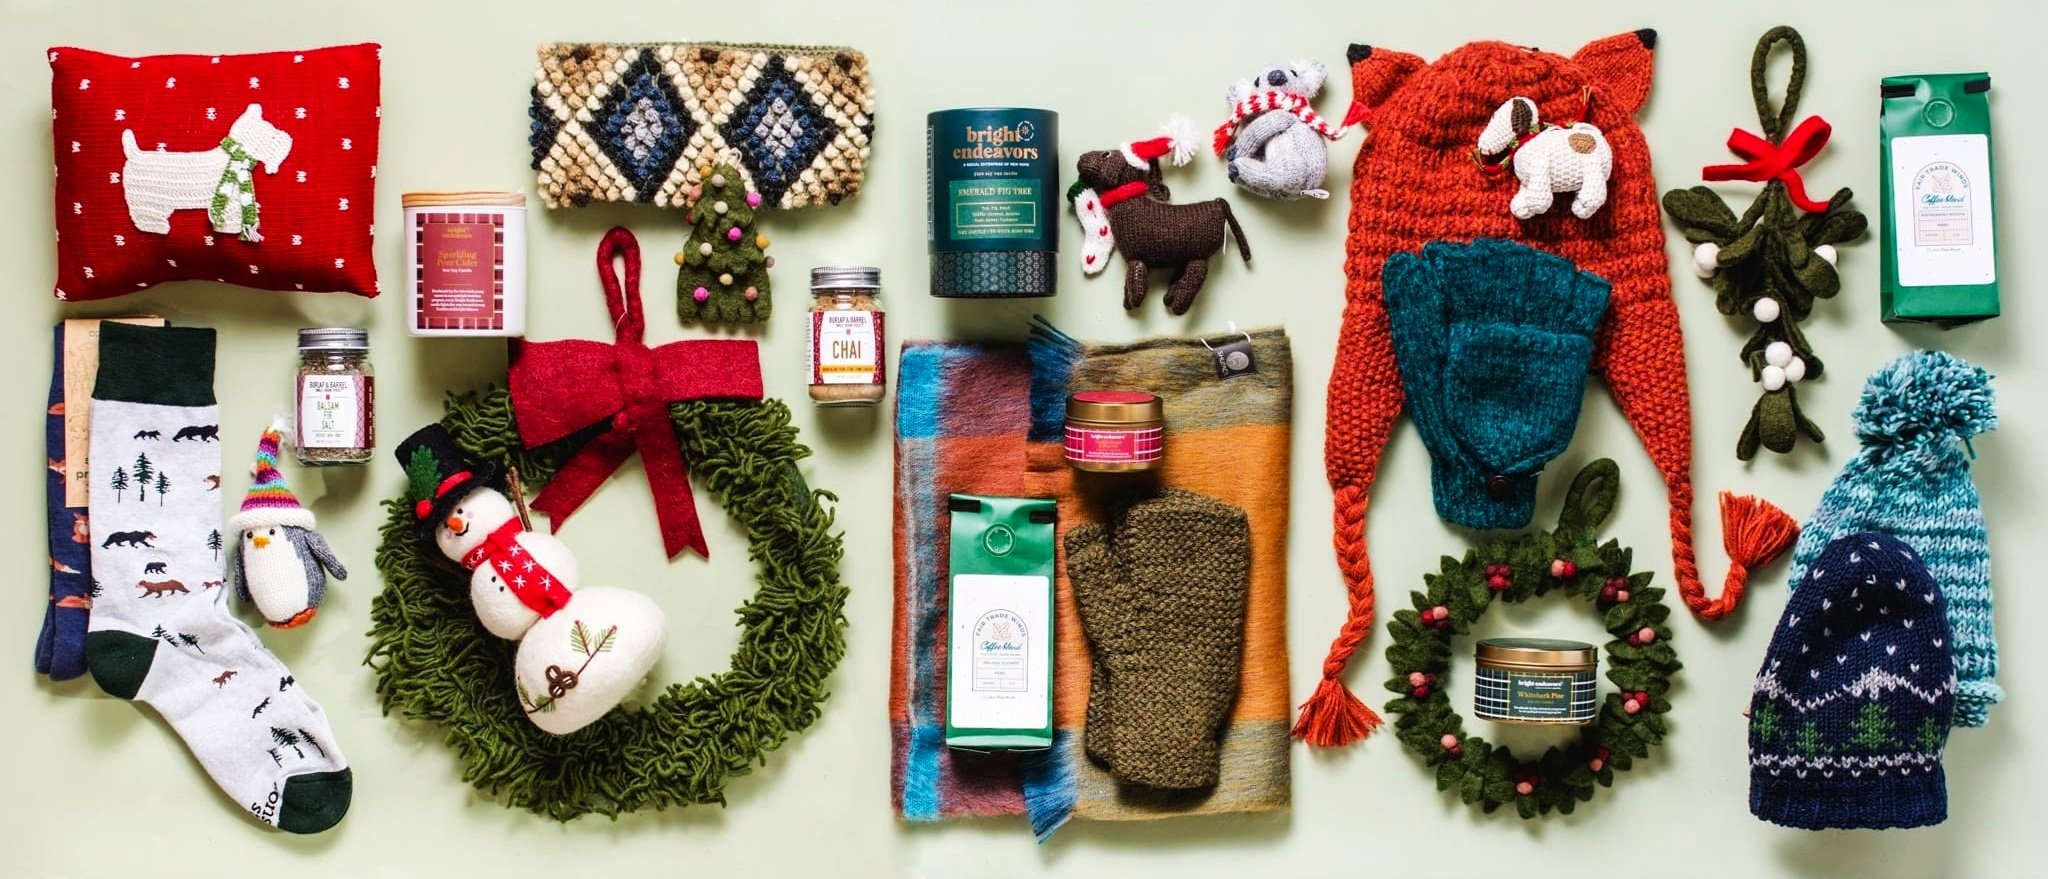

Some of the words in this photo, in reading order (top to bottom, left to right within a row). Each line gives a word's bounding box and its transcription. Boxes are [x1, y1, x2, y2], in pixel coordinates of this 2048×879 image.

[966, 126, 1021, 146] bright
[953, 143, 1038, 160] endeavors
[1916, 174, 1926, 190] FAIR
[1925, 165, 1949, 174] TRADE
[1952, 168, 1968, 189] WINDS
[958, 187, 995, 197] EMERALD
[997, 187, 1011, 195] FIG
[1013, 187, 1032, 195] TREE
[1921, 193, 1944, 205] Coffee
[1945, 194, 1966, 203] blend
[437, 250, 477, 260] Sparkling
[455, 258, 479, 267] Cider
[829, 316, 845, 324] BURLAP
[850, 316, 867, 325] BARREL
[832, 340, 861, 359] CHAI
[309, 381, 325, 389] BURLAP
[330, 381, 348, 390] BARREL
[317, 401, 339, 410] BALSAM
[323, 411, 332, 419] FIR
[321, 420, 335, 430] SALT
[976, 620, 986, 637] FAIR
[986, 613, 1008, 621] TRADE
[1011, 615, 1026, 637] WINDS
[980, 640, 1001, 653] Coffee
[1002, 642, 1023, 650] blend
